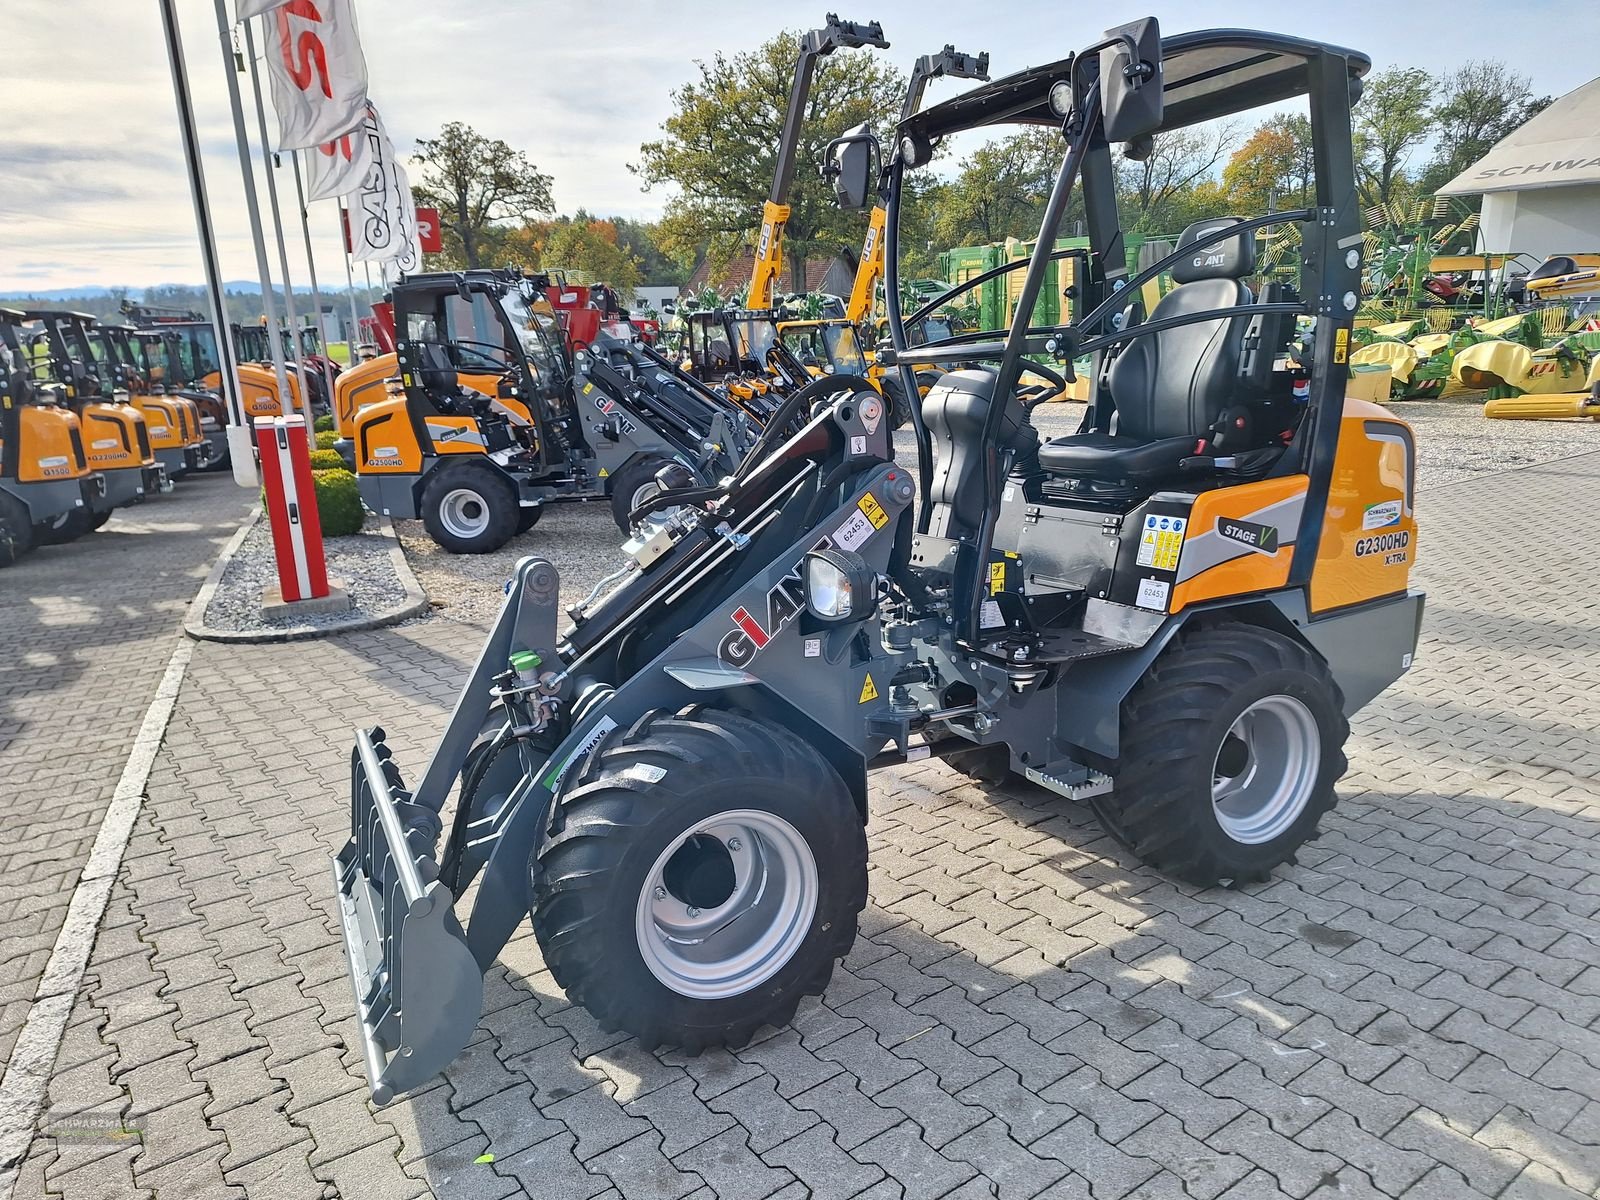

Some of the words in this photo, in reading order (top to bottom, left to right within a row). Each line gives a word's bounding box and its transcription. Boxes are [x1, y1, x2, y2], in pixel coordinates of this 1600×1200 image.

[757, 223, 771, 261] JCB
[862, 227, 877, 262] JCB
[43, 468, 70, 476] G1500
[843, 519, 865, 542] 62453
[1224, 525, 1257, 544] STAGE
[1259, 526, 1275, 546] V
[1355, 531, 1409, 557] G2300HD
[1384, 552, 1407, 566] X-TRA
[1143, 587, 1165, 599] 62453
